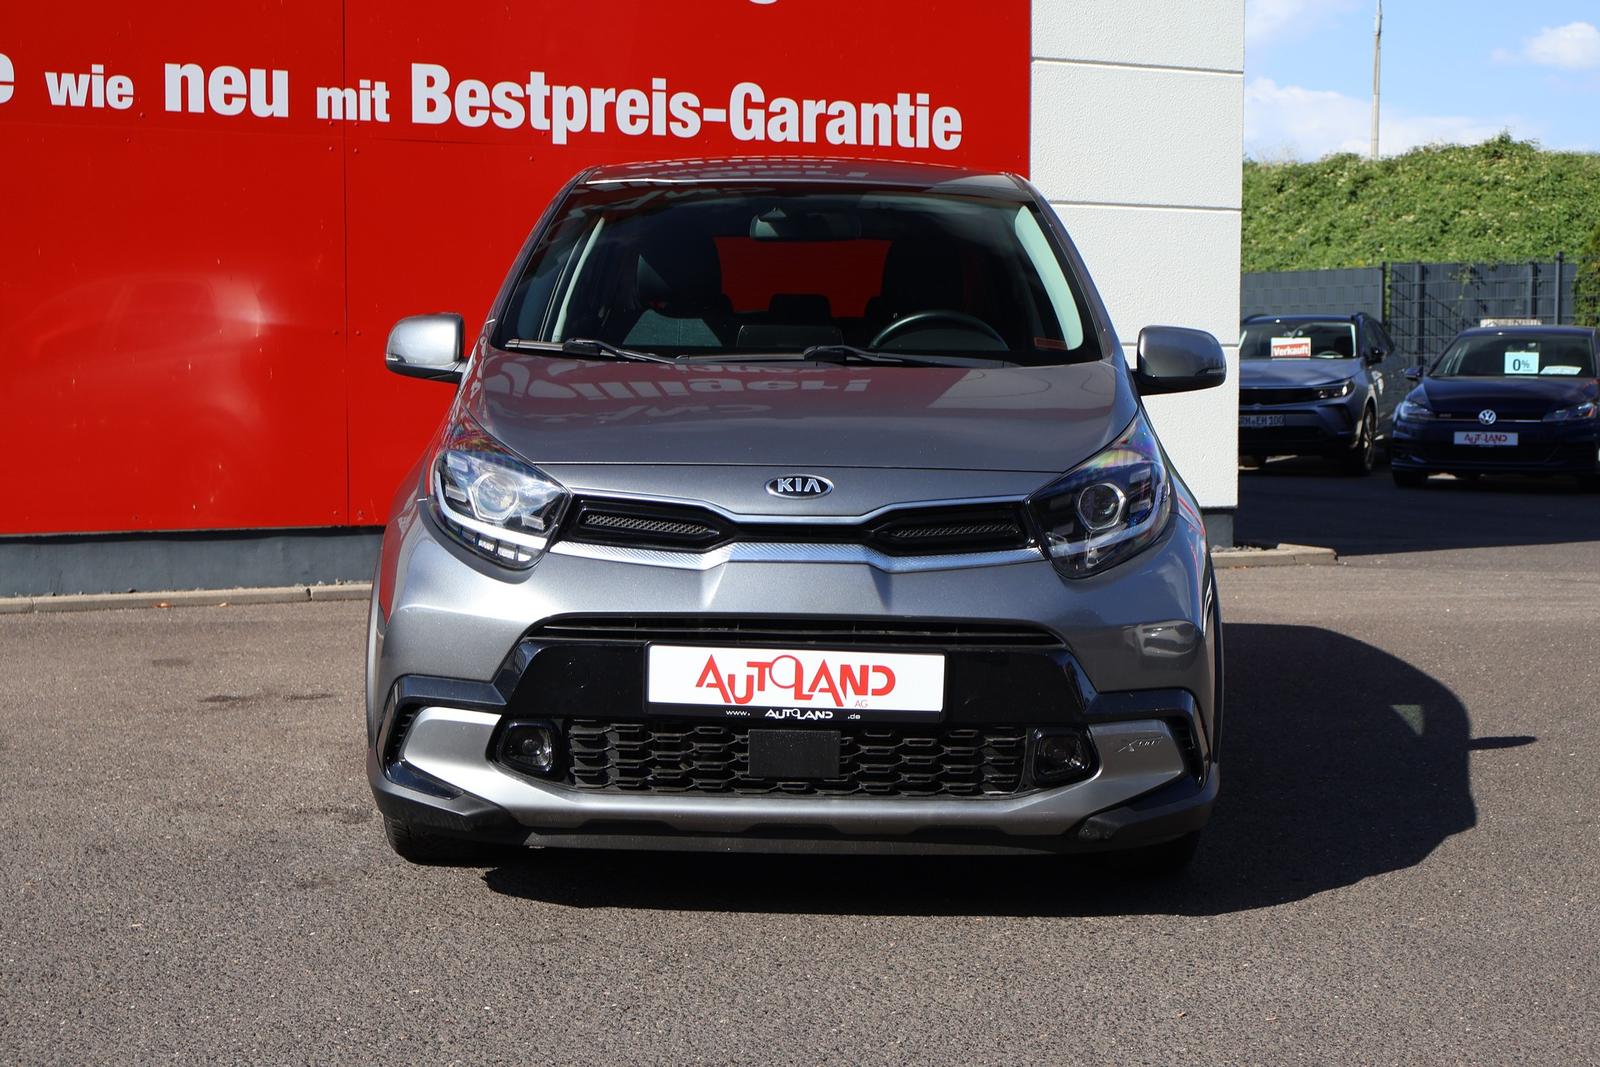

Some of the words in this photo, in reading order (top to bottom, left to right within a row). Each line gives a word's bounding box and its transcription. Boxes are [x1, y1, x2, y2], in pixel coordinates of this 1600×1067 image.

[45, 64, 133, 109] wie
[165, 63, 288, 117] neu
[317, 80, 390, 122] mit
[411, 63, 963, 150] Bestpreis-Garantie
[777, 478, 821, 492] KIA
[696, 654, 896, 707] AUTOLAND
[854, 699, 868, 708] AG
[765, 708, 835, 720] AUTOLAND
